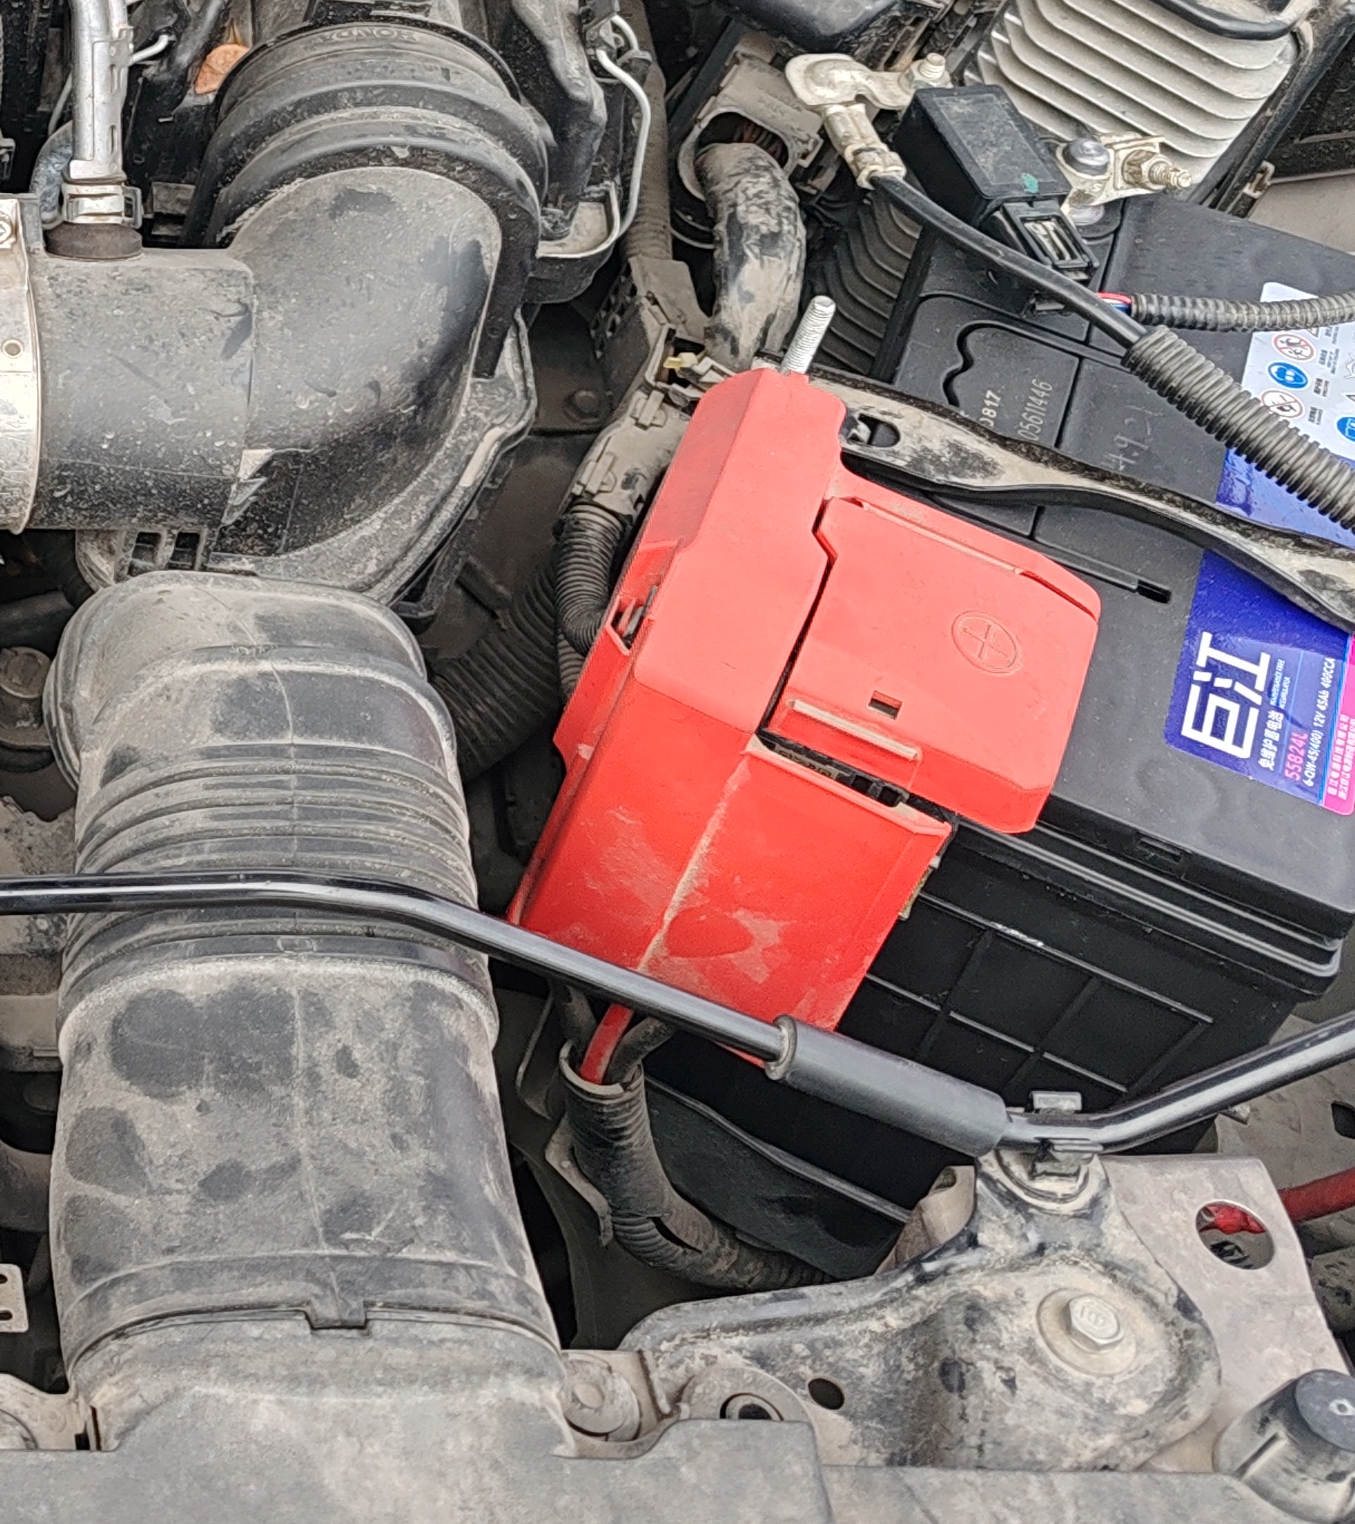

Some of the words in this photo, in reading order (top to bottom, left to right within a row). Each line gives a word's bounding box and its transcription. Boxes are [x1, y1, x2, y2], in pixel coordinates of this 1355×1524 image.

[1017, 378, 1054, 442] 05611446
[1180, 630, 1271, 758] 巨江
[1313, 711, 1326, 728] 12V
